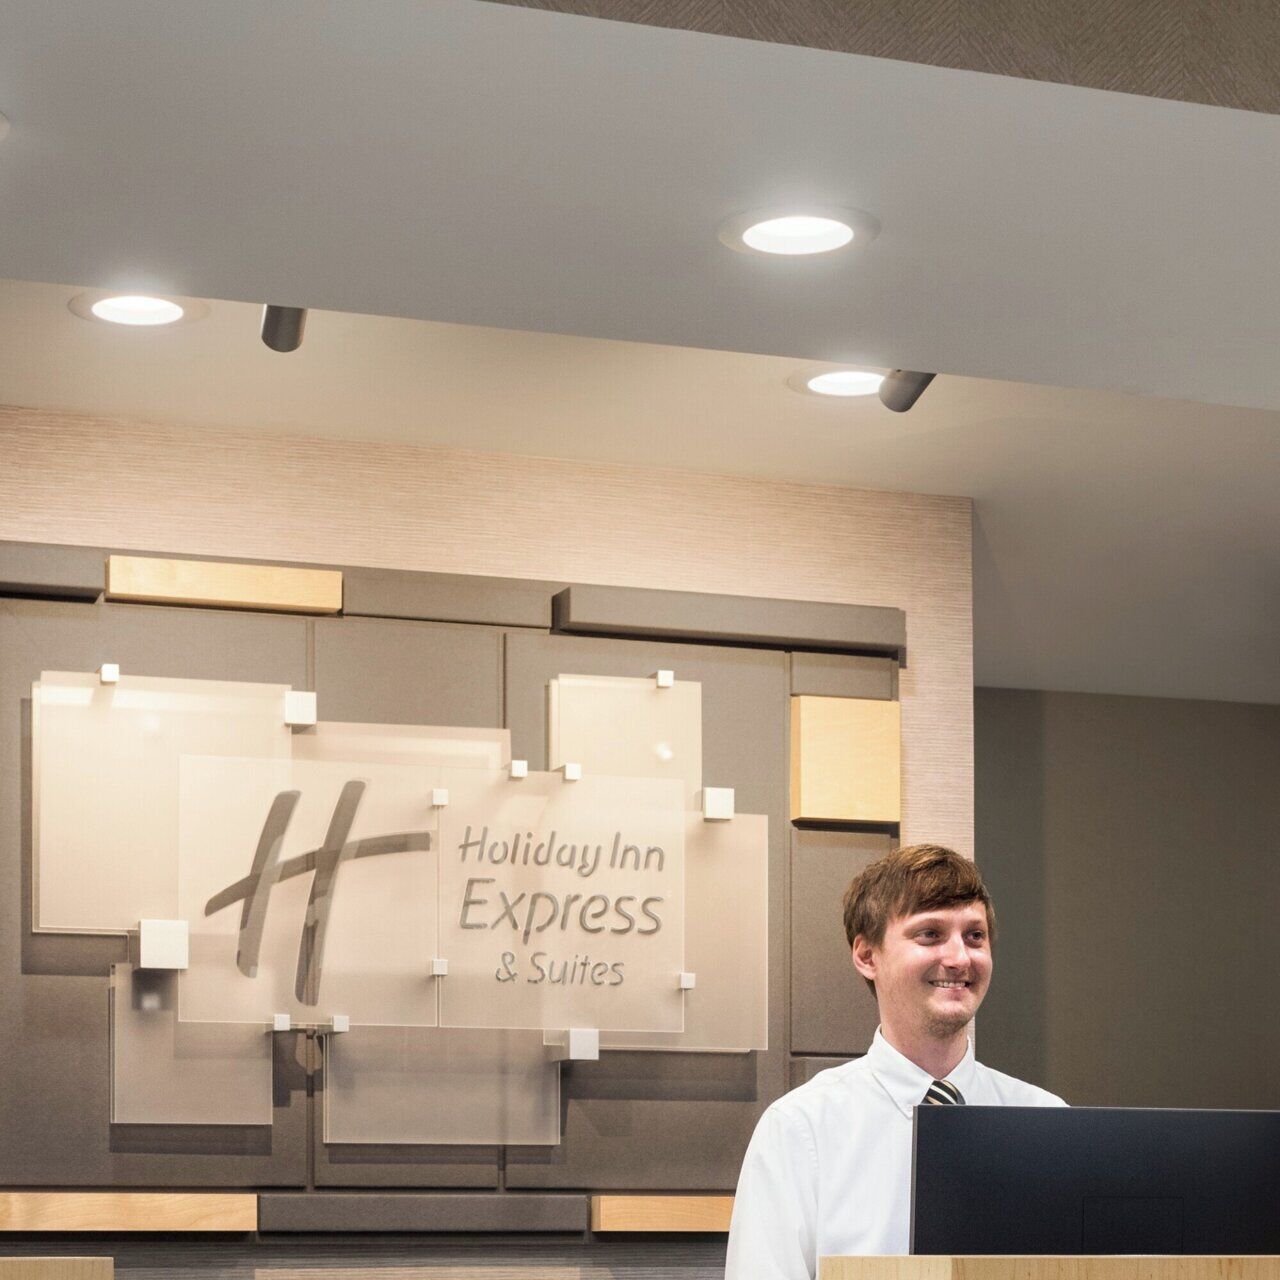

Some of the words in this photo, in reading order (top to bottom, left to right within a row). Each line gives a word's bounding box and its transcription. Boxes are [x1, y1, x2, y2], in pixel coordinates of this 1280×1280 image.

[458, 825, 603, 878] Holiday
[609, 831, 665, 872] Inn
[459, 877, 665, 945] Express
[495, 951, 518, 983] &
[526, 951, 625, 986] Suites
